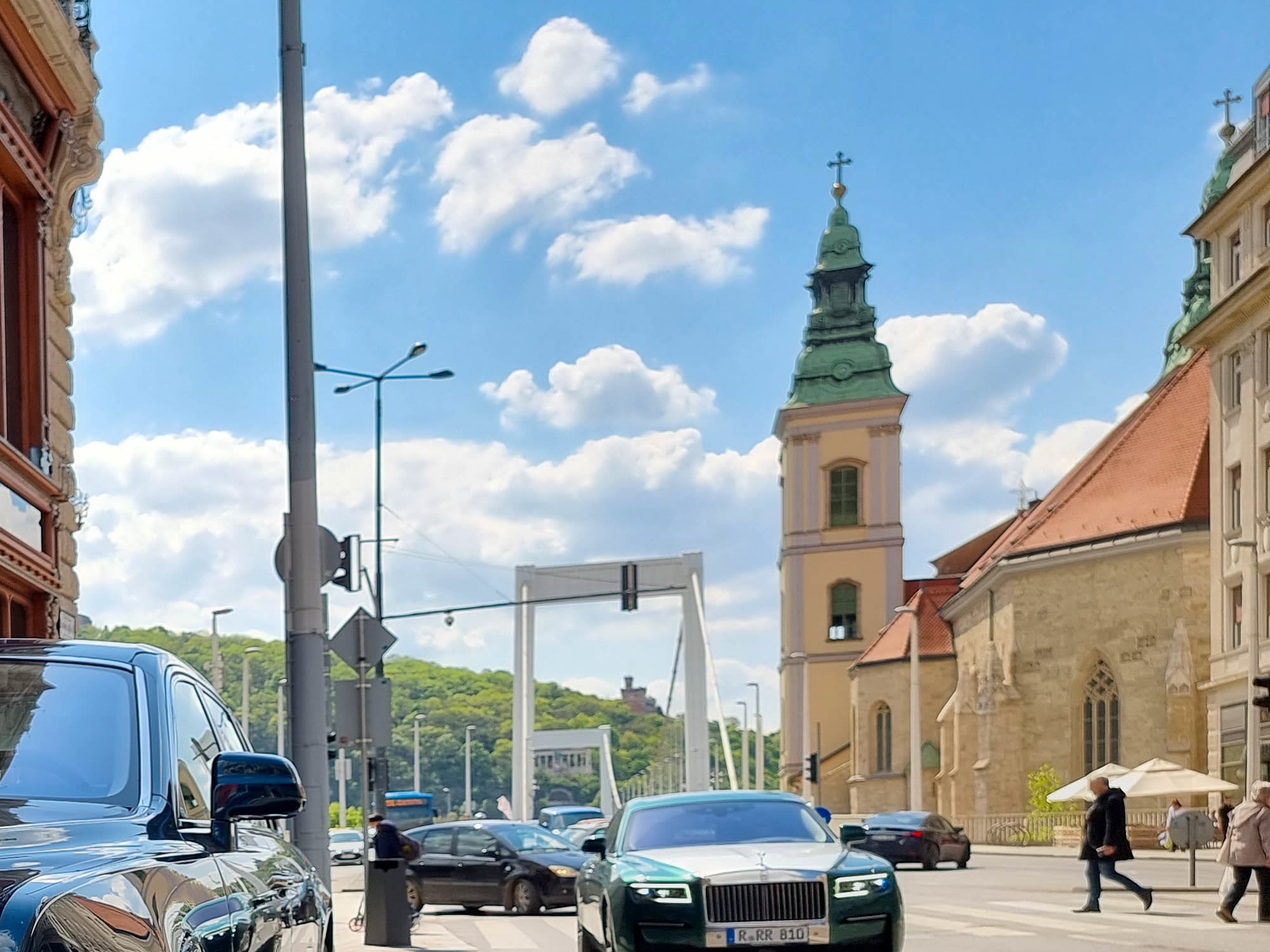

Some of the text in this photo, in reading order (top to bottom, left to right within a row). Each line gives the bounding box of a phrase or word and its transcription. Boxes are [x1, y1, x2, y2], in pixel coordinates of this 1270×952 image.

[738, 929, 747, 941] R
[756, 929, 773, 941] RR
[780, 928, 804, 940] 810
